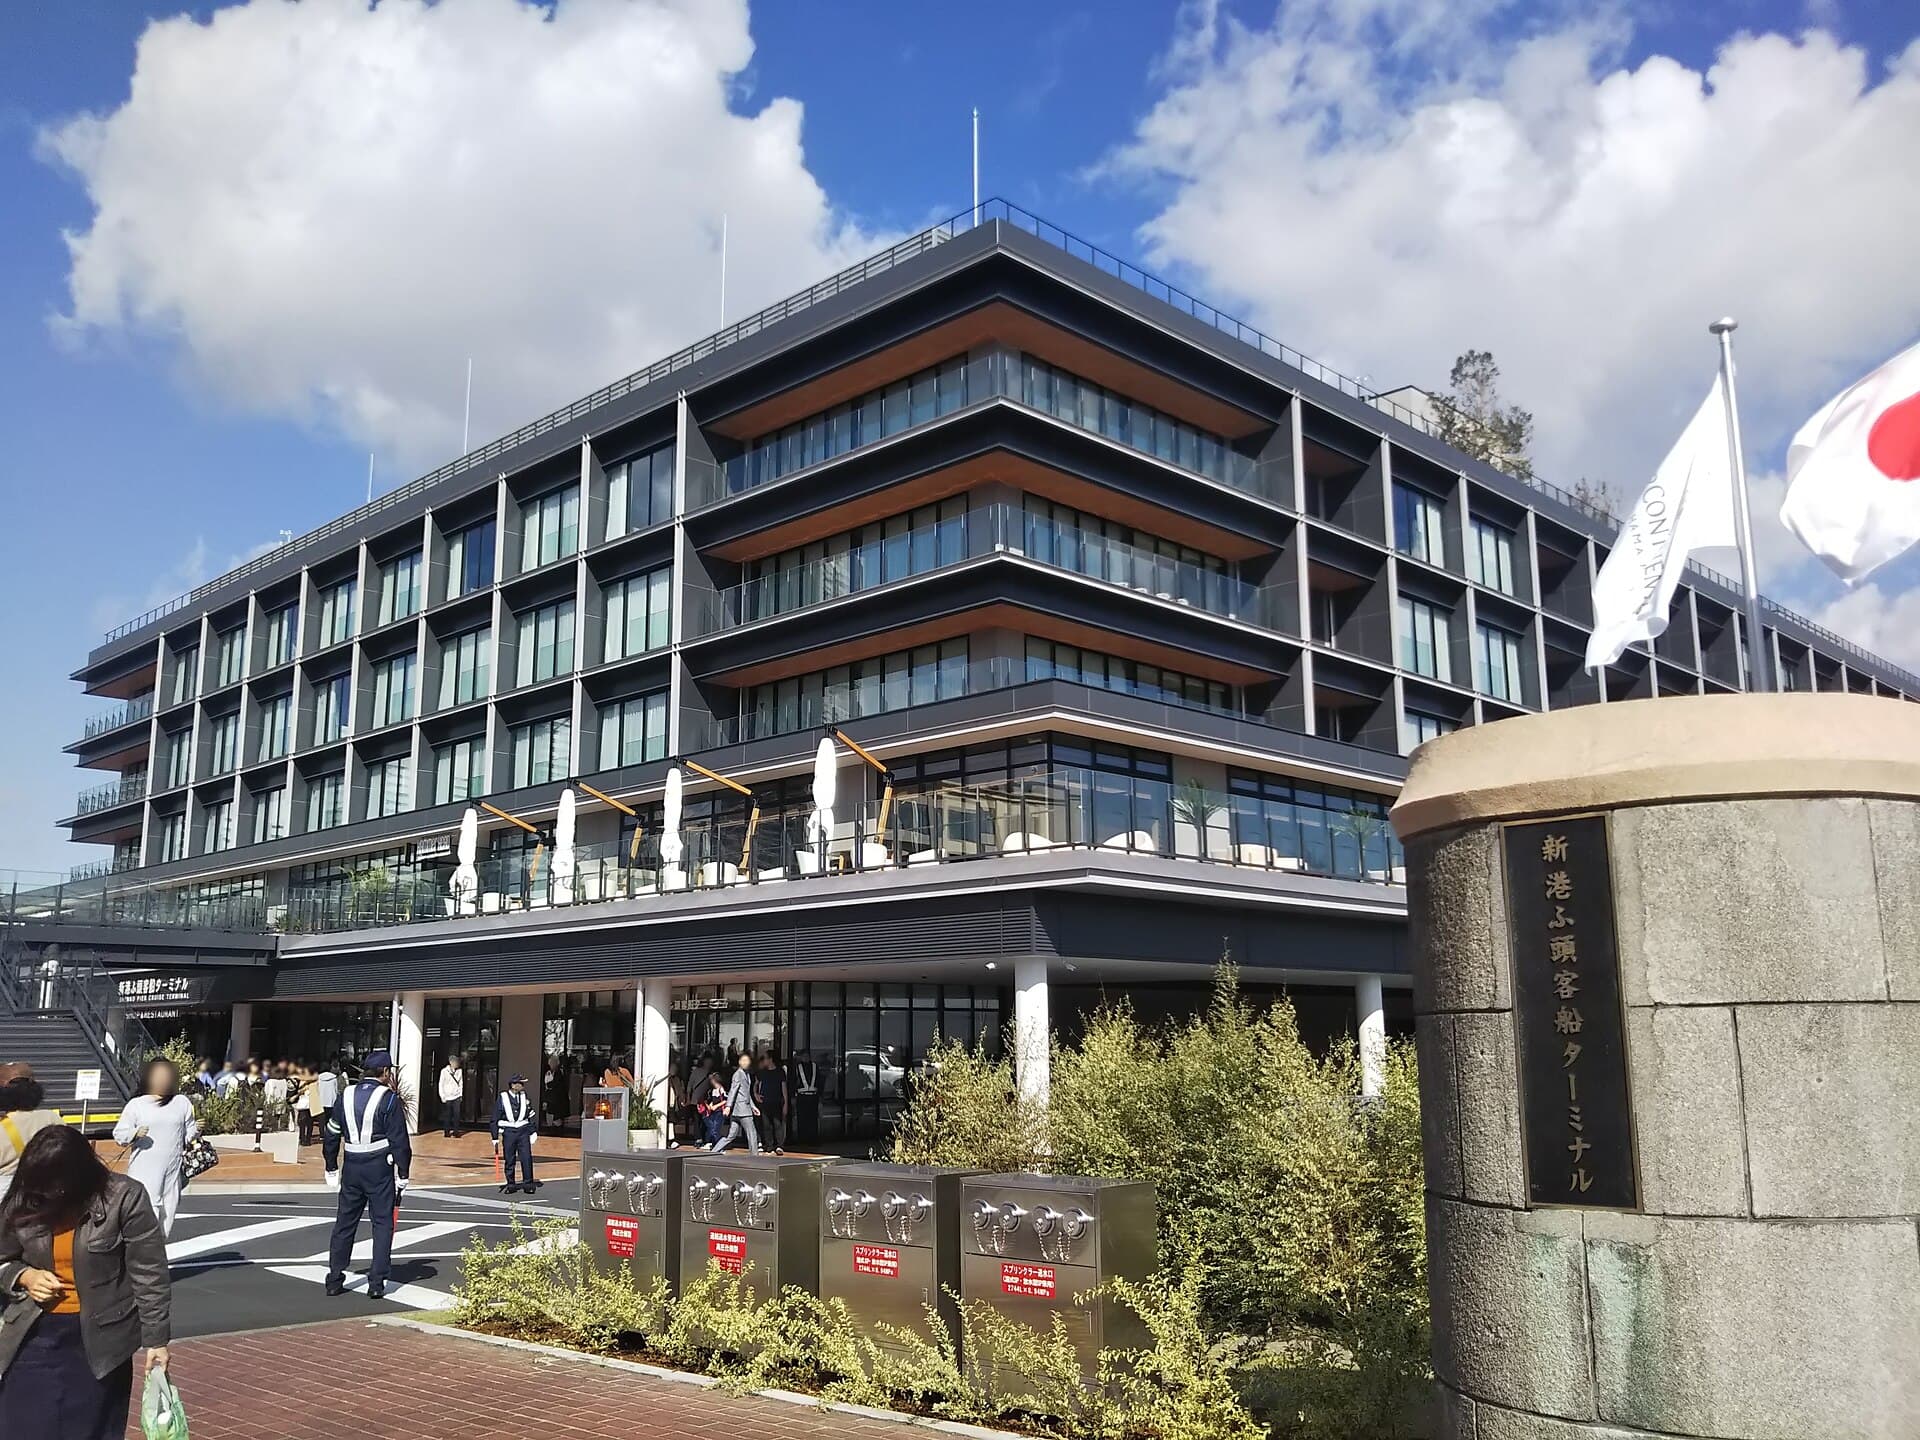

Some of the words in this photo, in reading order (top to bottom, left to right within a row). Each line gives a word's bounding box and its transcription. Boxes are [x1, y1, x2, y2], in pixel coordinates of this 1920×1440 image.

[1542, 834, 1595, 1194] 新港ふ頭客船ターミナル
[1003, 1264, 1053, 1278] スプリンクラー送水口
